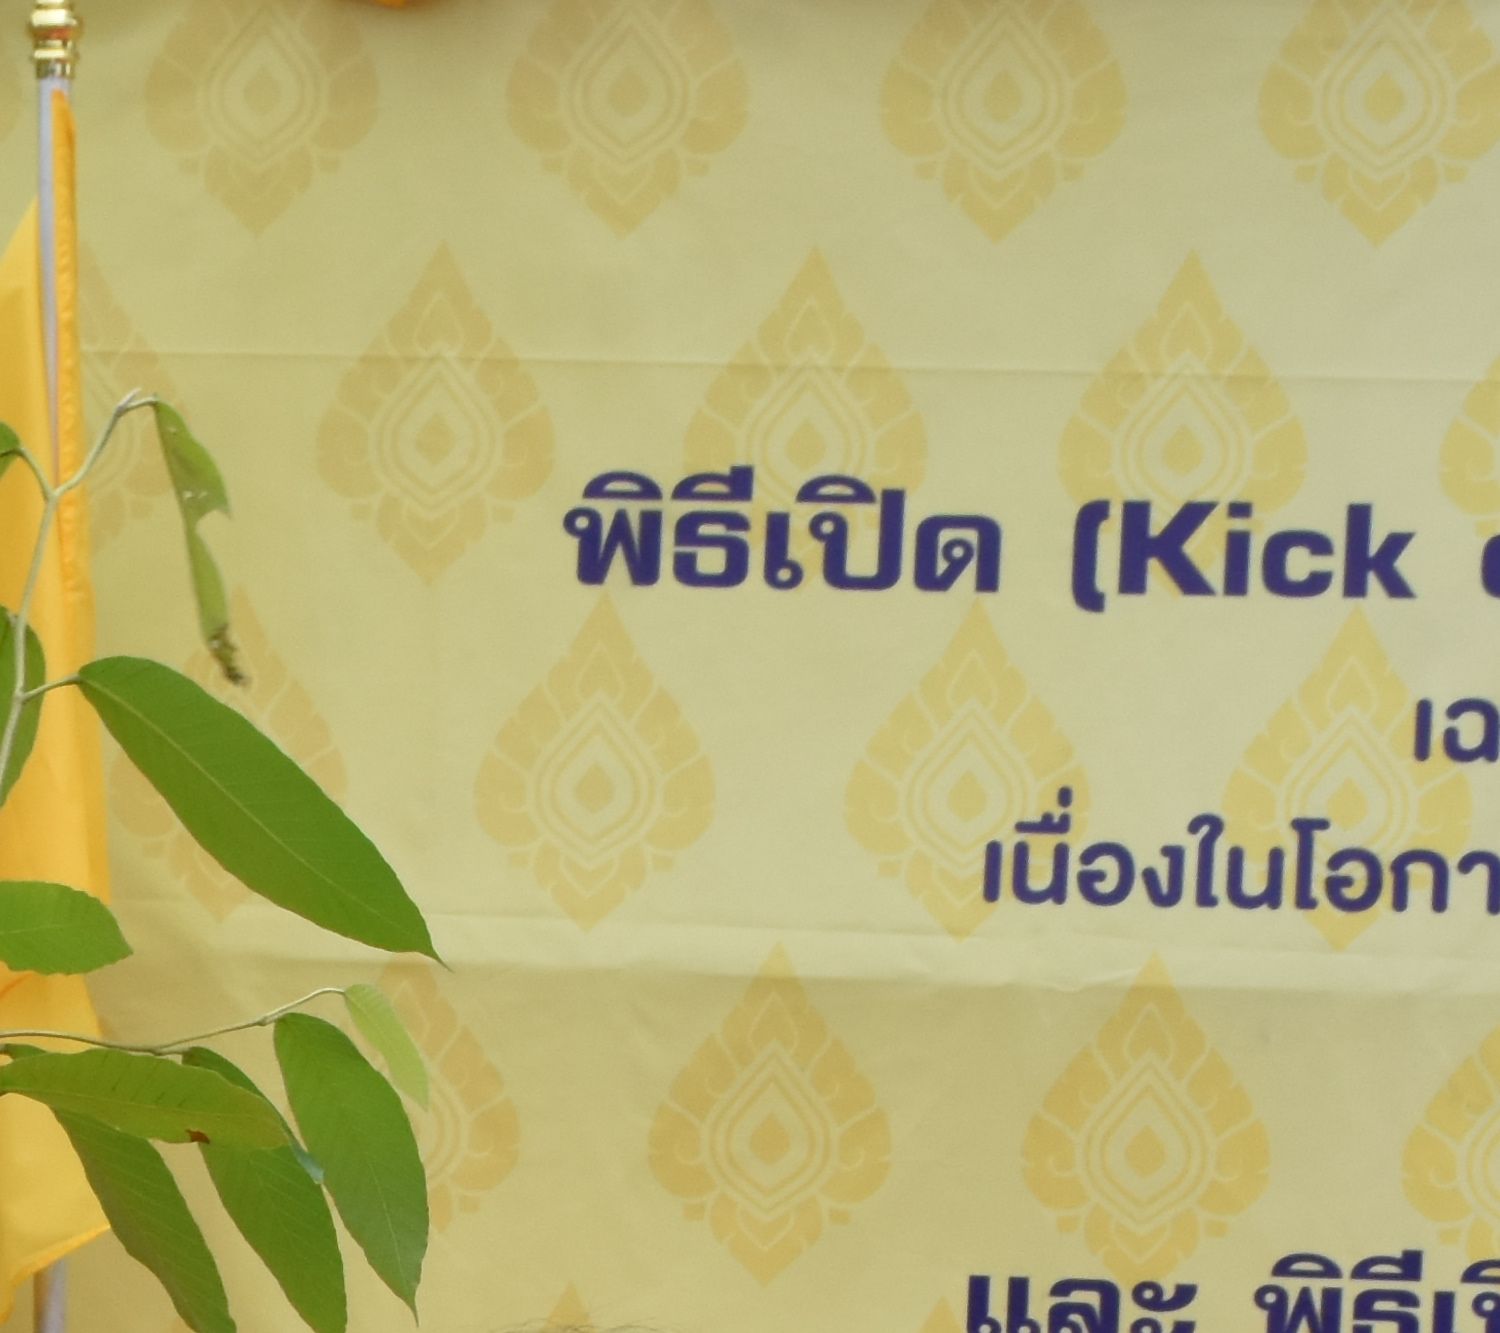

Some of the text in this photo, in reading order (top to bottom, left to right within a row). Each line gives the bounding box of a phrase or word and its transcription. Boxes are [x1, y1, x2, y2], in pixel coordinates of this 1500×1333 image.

[563, 464, 1003, 594] พิธีเปิด
[1071, 499, 1416, 614] (Kick
